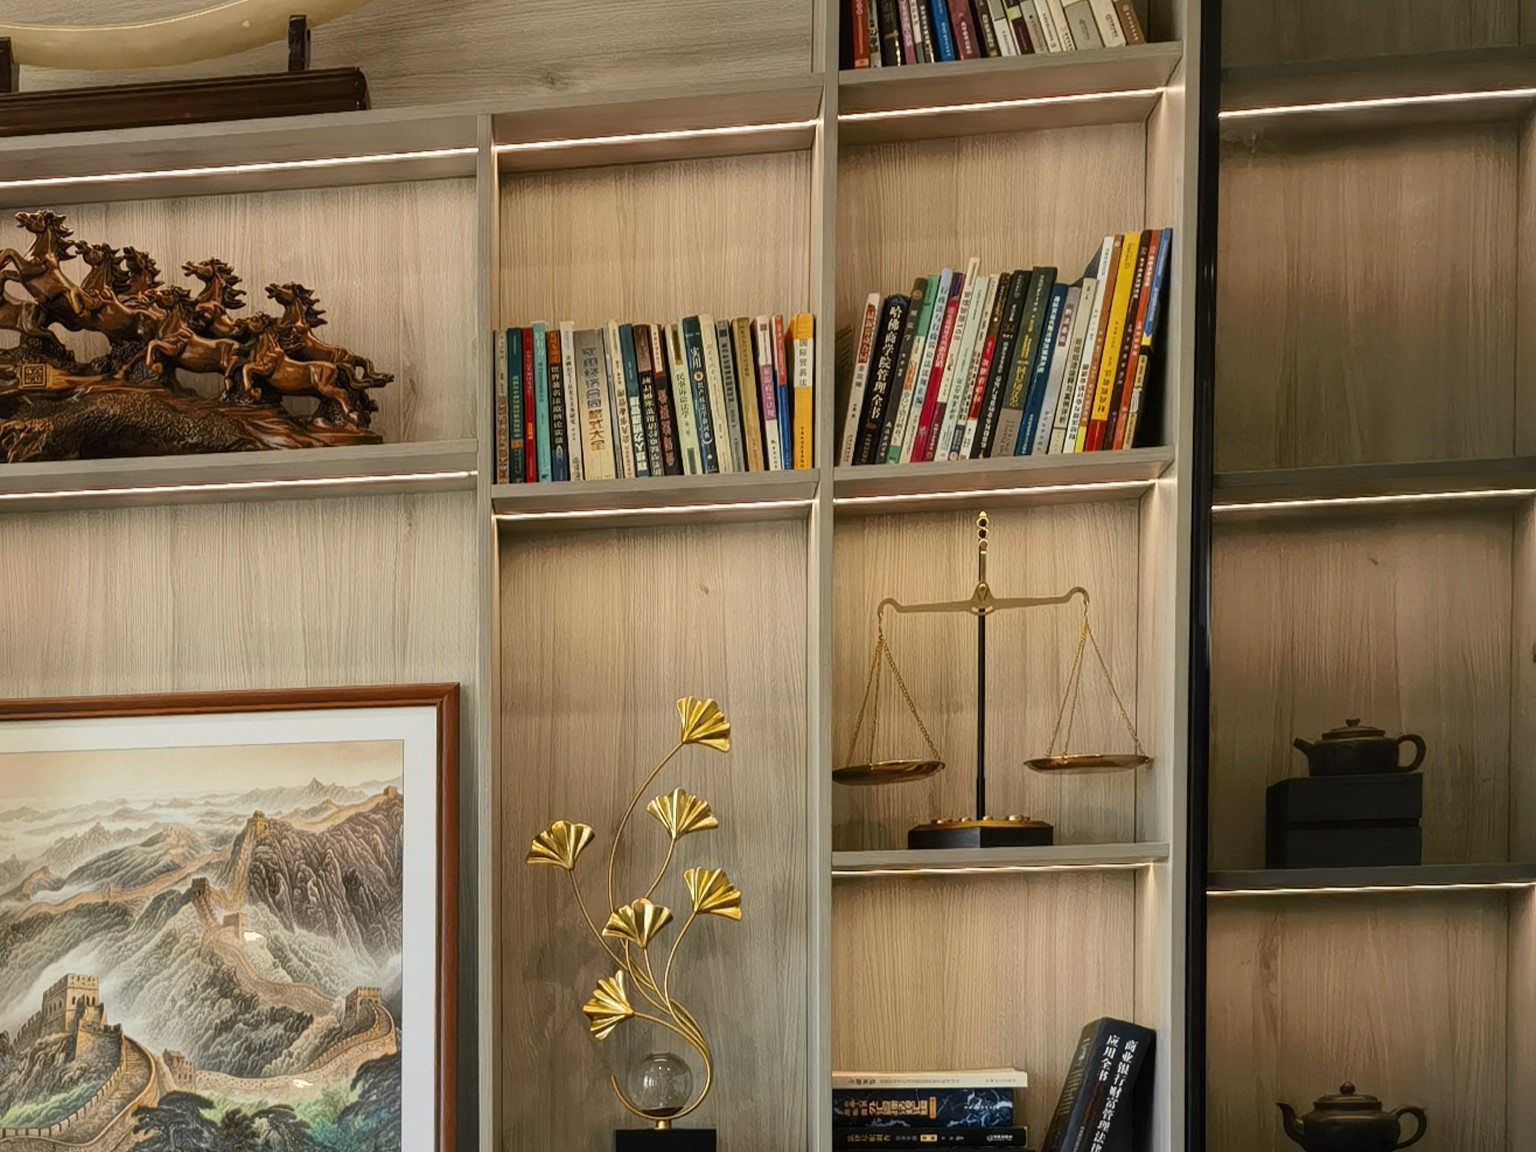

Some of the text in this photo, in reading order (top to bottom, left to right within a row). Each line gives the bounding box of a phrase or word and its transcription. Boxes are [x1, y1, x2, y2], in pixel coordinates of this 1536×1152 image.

[798, 339, 807, 387] 国际贸易法
[871, 305, 903, 420] 哈佛商学院管理全书
[1098, 1034, 1121, 1082] 应用全书
